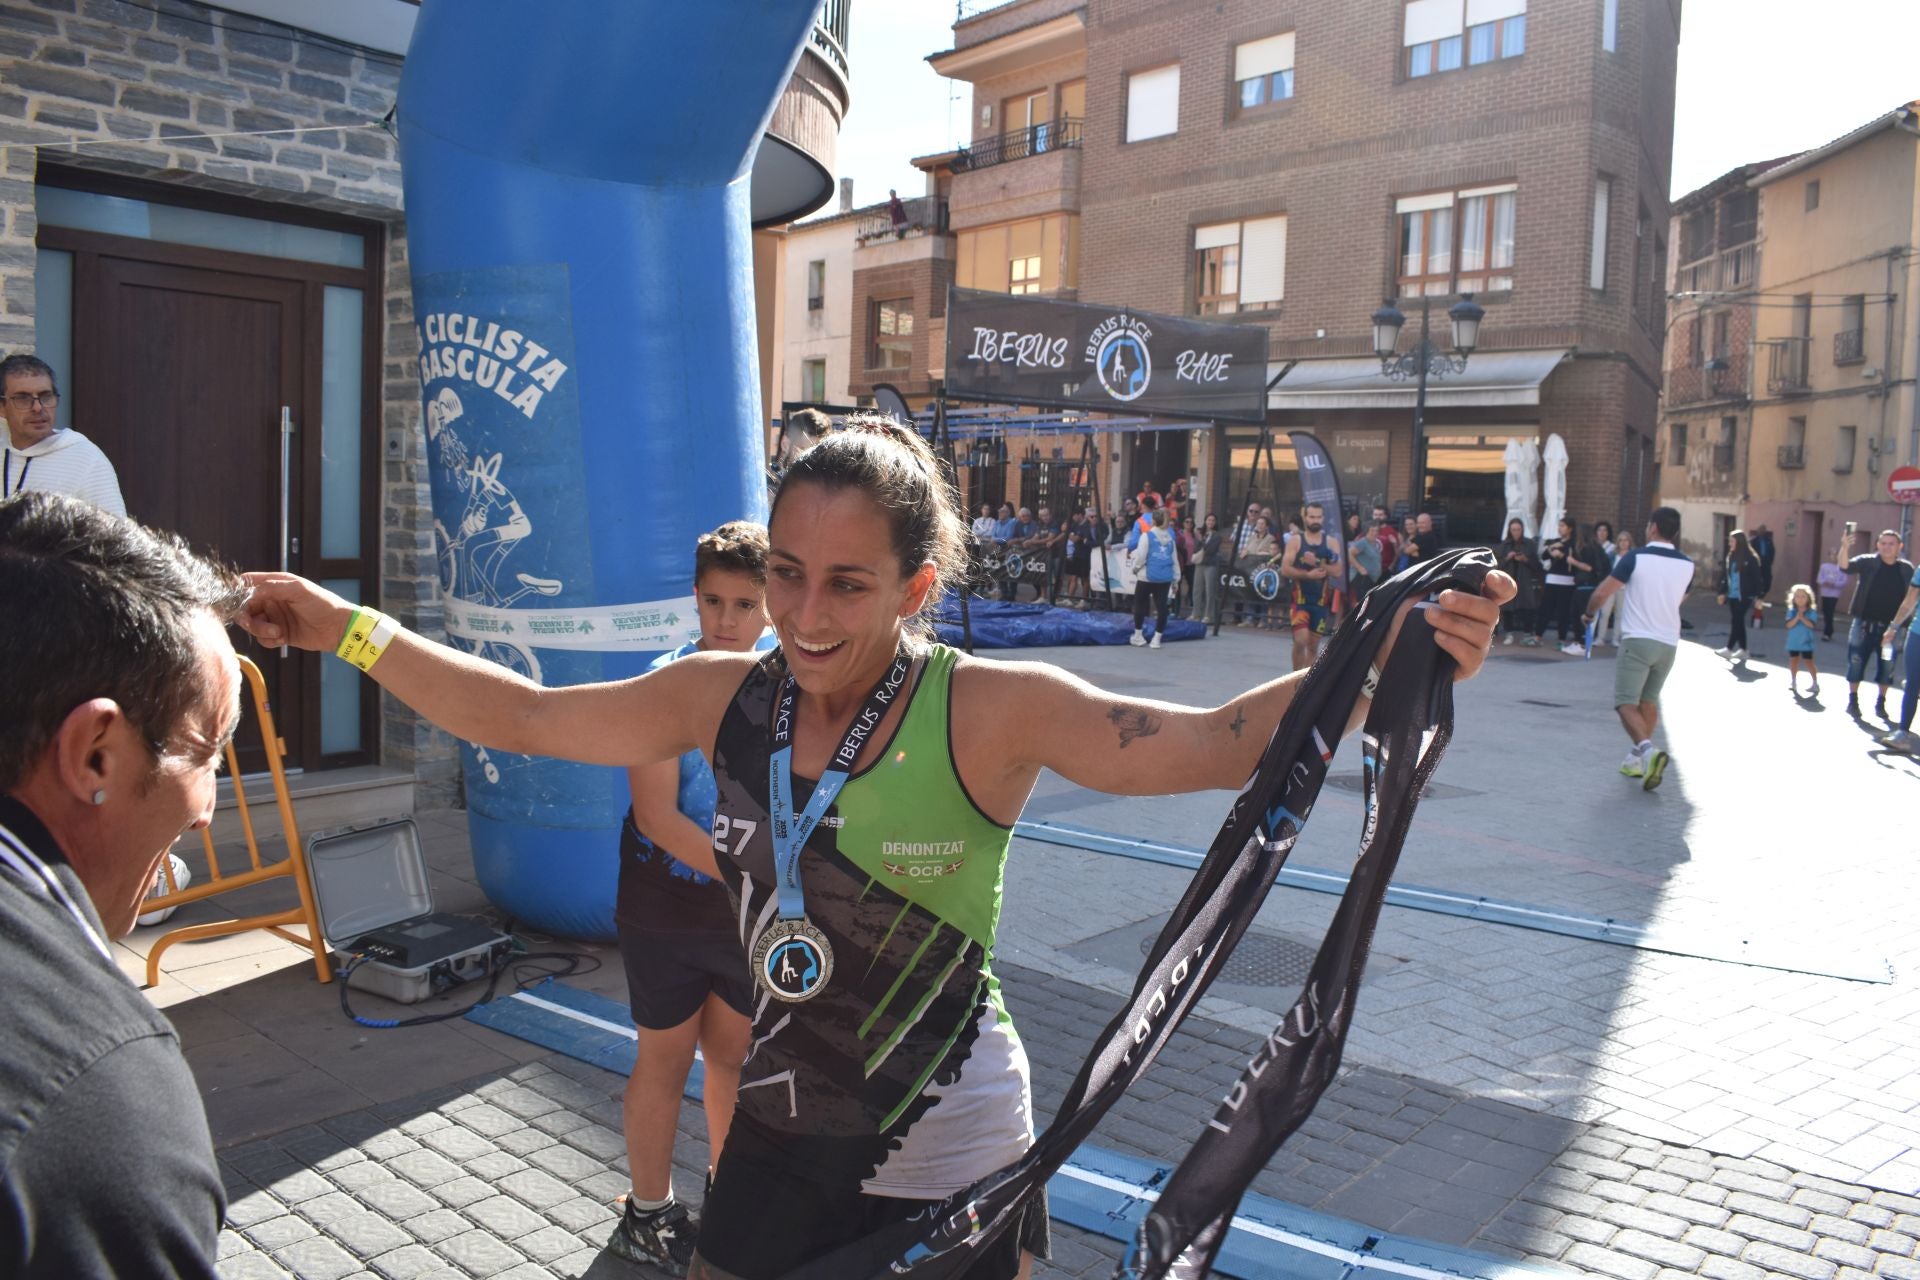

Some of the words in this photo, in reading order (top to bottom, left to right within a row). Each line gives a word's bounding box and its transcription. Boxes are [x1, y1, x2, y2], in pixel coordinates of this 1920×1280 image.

[425, 313, 568, 393] CICLISTA
[968, 327, 1068, 368] IBERUS
[1175, 349, 1233, 384] RACE
[1084, 316, 1118, 363] IBERUS
[1120, 314, 1153, 342] RACE
[420, 346, 544, 419] BASCULA
[1335, 435, 1347, 447] La
[1350, 436, 1385, 452] esquina
[1026, 557, 1046, 573] dica
[775, 695, 793, 742] RACE
[835, 707, 880, 767] IBERUS
[881, 661, 908, 705] RACE
[772, 759, 780, 801] NORTHERN
[712, 811, 757, 856] 27
[773, 810, 782, 840] LEAGUE
[882, 840, 965, 856] DENONTZAT
[909, 865, 943, 877] OCR
[754, 926, 785, 965] IBERUS
[787, 923, 824, 941] RACE
